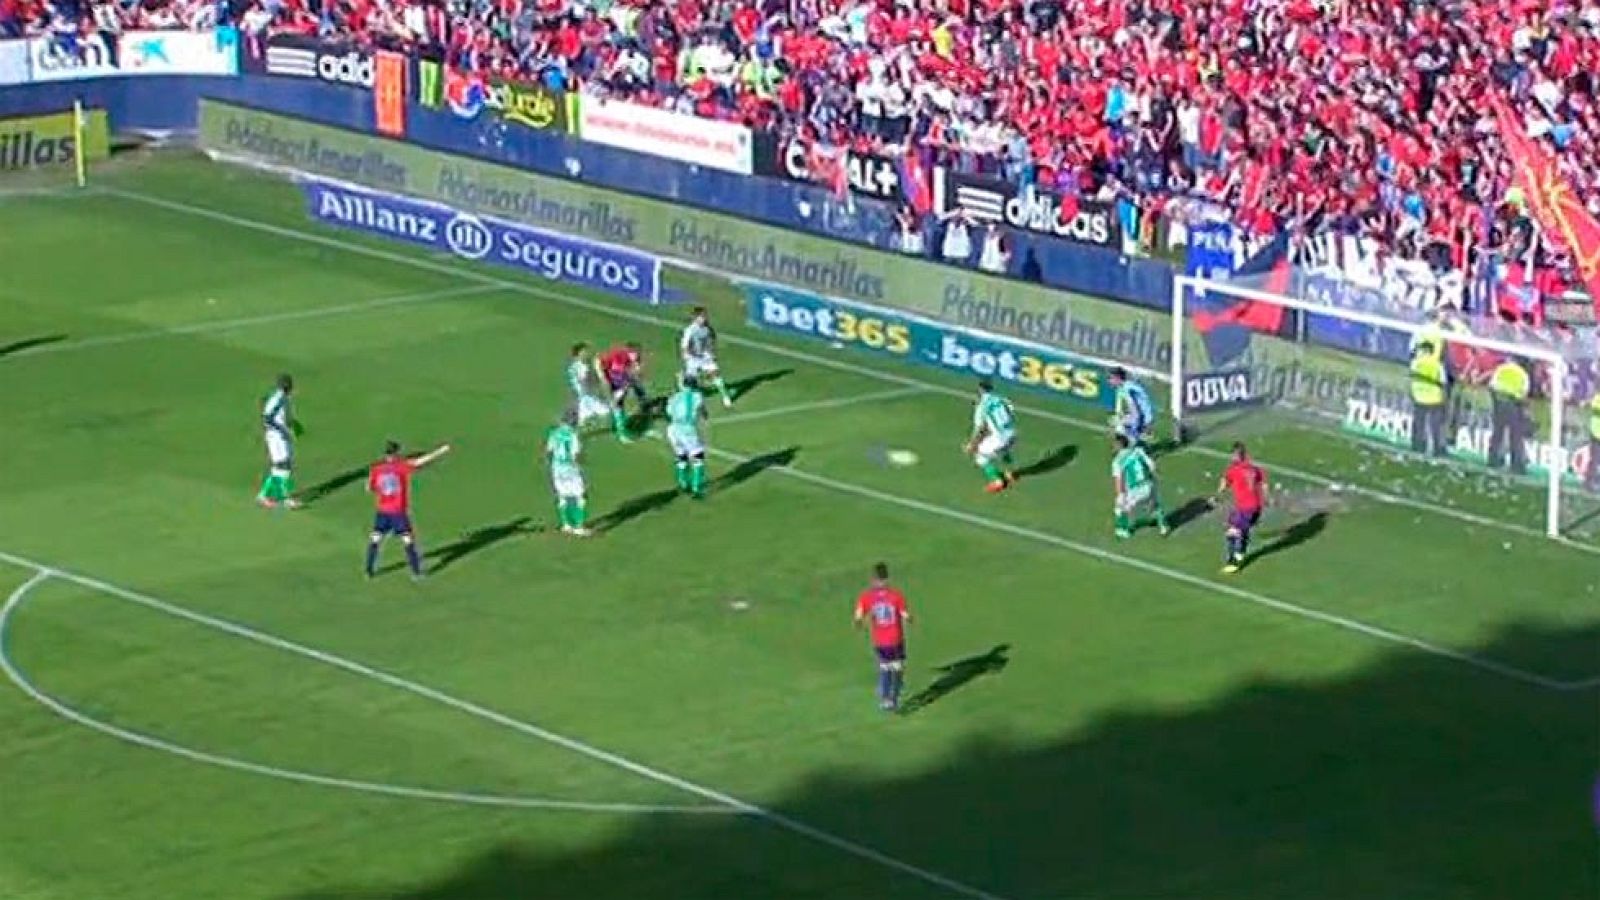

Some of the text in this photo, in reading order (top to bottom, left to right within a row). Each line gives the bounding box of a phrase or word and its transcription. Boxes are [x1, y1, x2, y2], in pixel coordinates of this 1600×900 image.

[786, 139, 898, 195] CAL+
[319, 189, 641, 291] Allianz Seguros
[1006, 184, 1109, 244] adidas
[763, 296, 910, 354] bet365
[940, 334, 1101, 398] bet365
[1186, 372, 1249, 408] BBVA
[1346, 398, 1413, 441] TURKI
